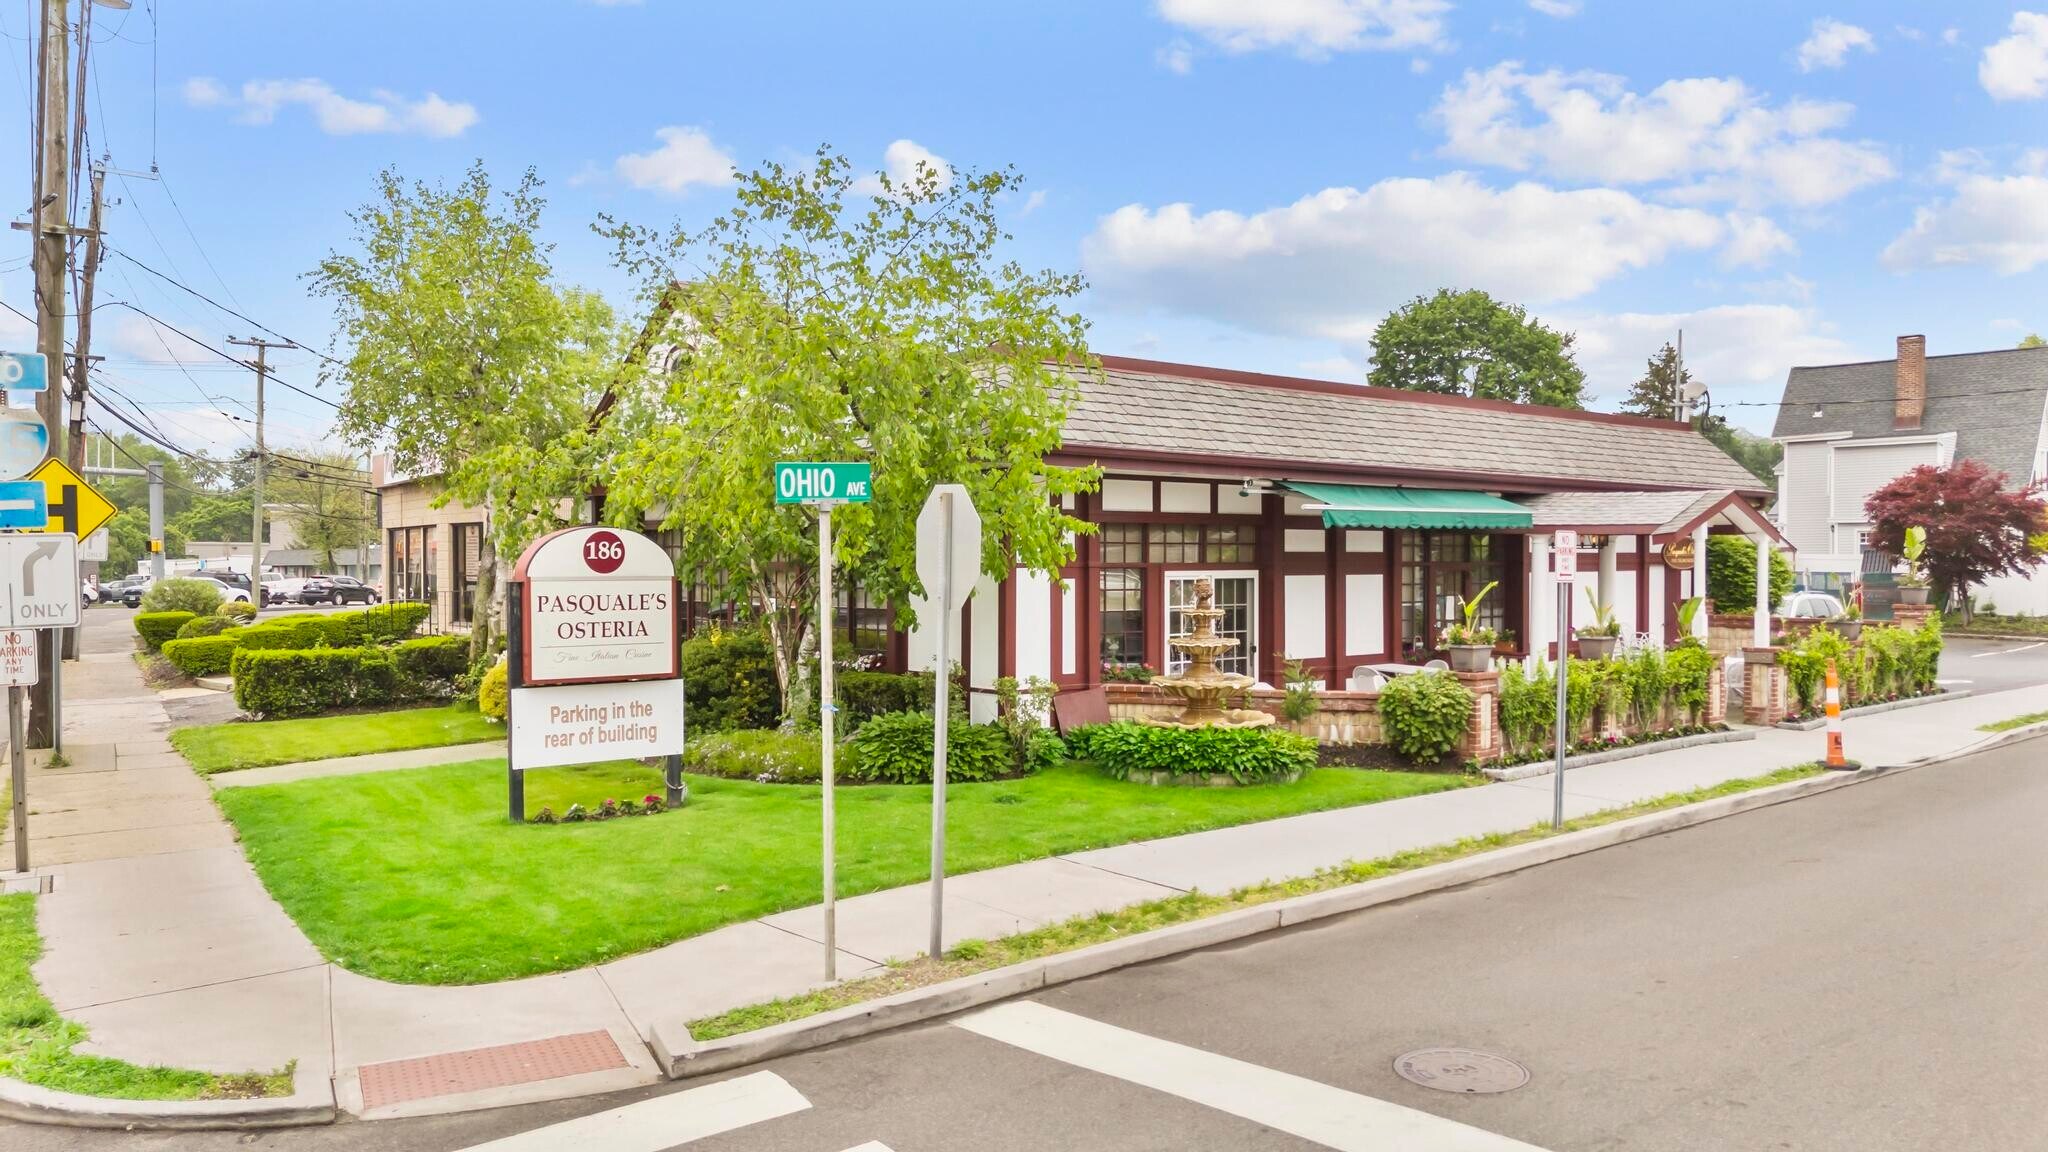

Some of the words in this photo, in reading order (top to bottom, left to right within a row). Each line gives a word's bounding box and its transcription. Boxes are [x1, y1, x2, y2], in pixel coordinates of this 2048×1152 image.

[779, 467, 836, 498] OHIO
[846, 481, 867, 497] AVE
[586, 541, 622, 560] 186
[20, 603, 68, 618] ONLY
[537, 593, 667, 615] PASQUALE'S
[557, 620, 649, 639] OSTERIA
[5, 633, 21, 646] NO
[0, 645, 33, 657] ARKING
[553, 651, 579, 663] Fine
[586, 649, 620, 661] Italian
[625, 648, 653, 659] Cuisine
[5, 665, 25, 674] TIME
[6, 657, 23, 666] ANY
[550, 704, 608, 725] Parking
[612, 701, 625, 719] in
[629, 700, 653, 718] the
[544, 731, 575, 748] rear
[579, 726, 594, 745] of
[598, 723, 658, 744] building
